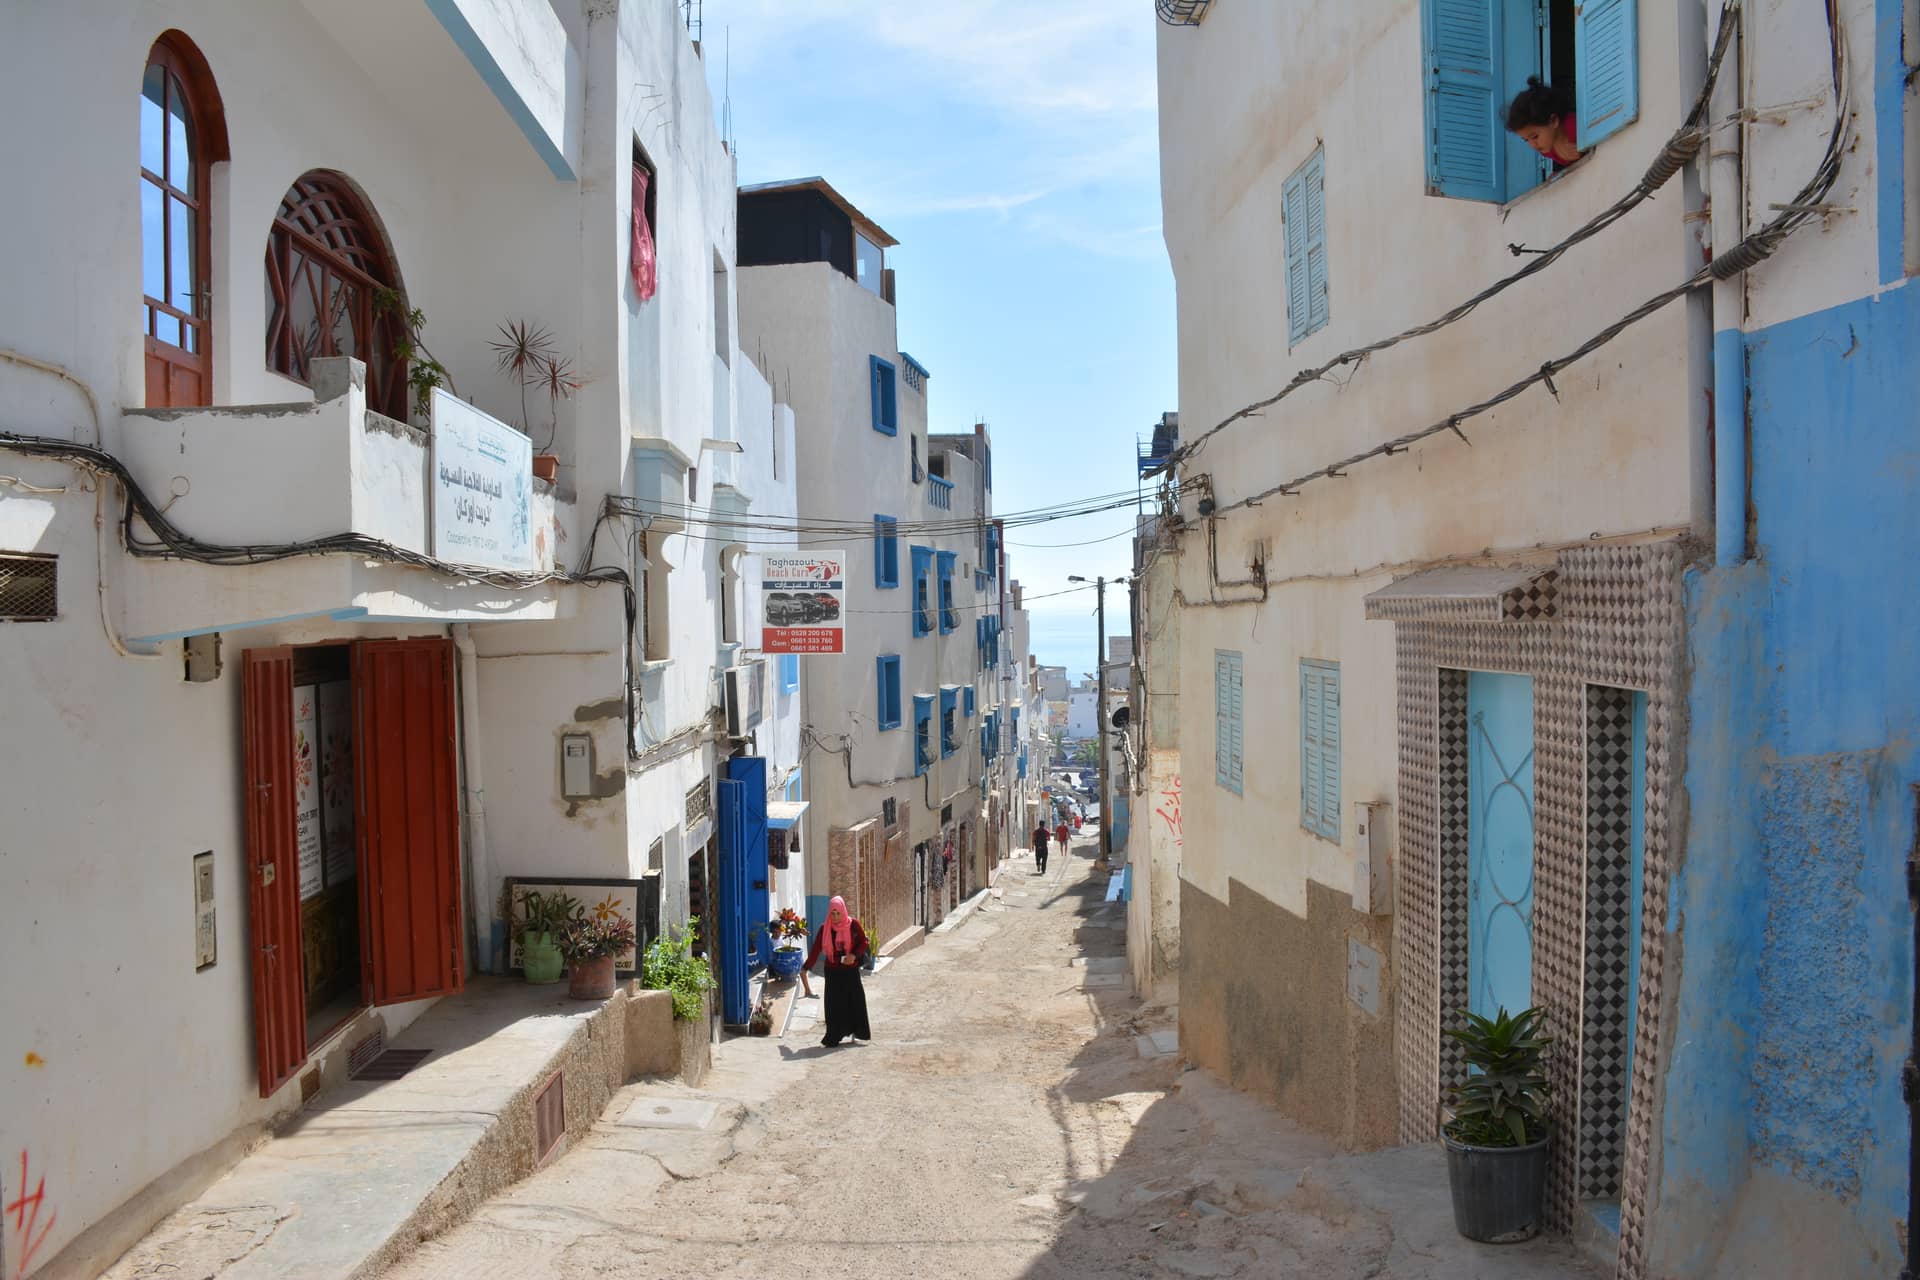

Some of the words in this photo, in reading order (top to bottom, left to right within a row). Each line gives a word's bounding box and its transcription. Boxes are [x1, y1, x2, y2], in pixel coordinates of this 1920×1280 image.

[767, 558, 815, 568] Taghazout
[766, 567, 789, 577] Beach
[792, 567, 809, 577] Cars
